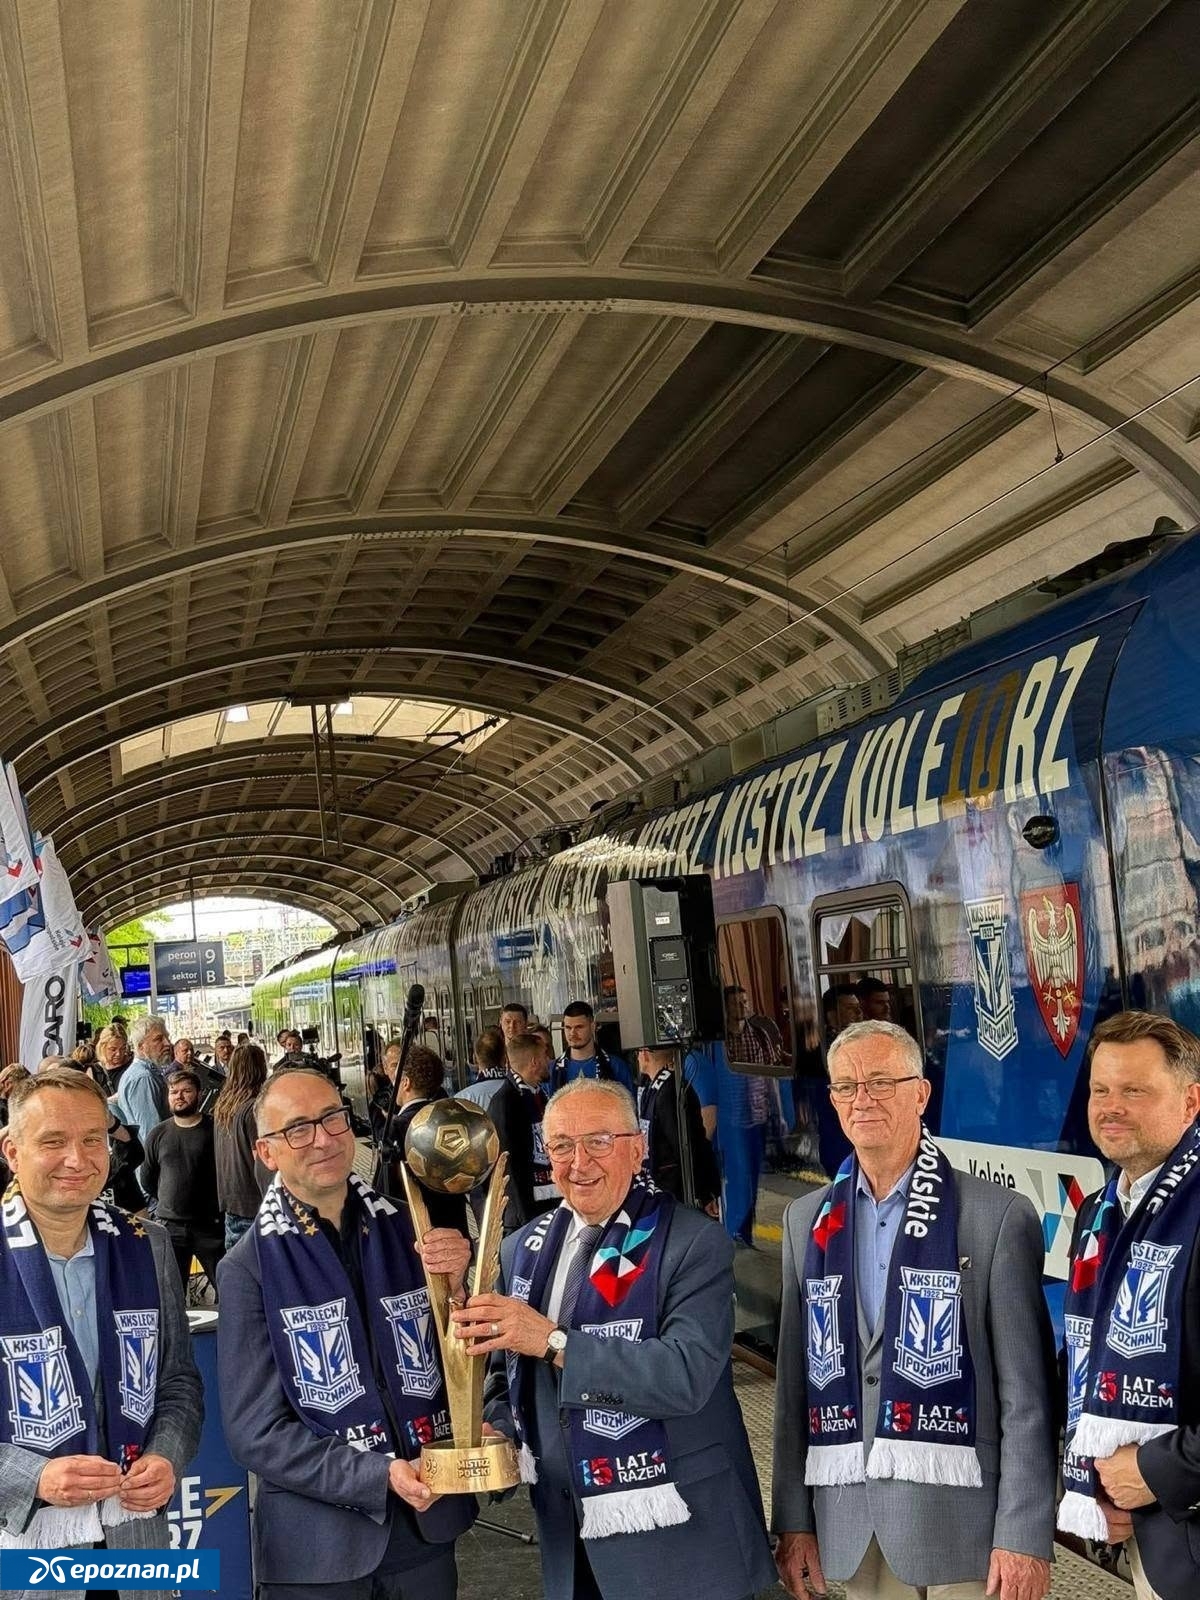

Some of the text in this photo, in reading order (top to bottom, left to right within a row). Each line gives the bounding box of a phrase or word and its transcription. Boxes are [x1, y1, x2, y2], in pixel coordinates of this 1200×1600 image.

[713, 739, 849, 880] MISTRZ
[168, 948, 216, 964] peron 9
[172, 970, 216, 983] sektor B
[1134, 1260, 1153, 1271] 1922
[909, 1272, 957, 1289] KKS LECH
[923, 1289, 941, 1299] 1922
[119, 1314, 138, 1327] KKS
[291, 1304, 339, 1325] KKS LECH
[309, 1323, 328, 1332] 1922
[1073, 1321, 1091, 1336] LEC
[13, 1337, 37, 1353] KKS
[1122, 1374, 1155, 1393] LAT
[1122, 1391, 1174, 1409] RAZEM
[432, 1410, 447, 1426] LAT
[820, 1405, 839, 1419] LAT
[882, 1399, 952, 1433] 15 LAT
[434, 1422, 451, 1439] RAZE
[821, 1417, 857, 1432] RAZEM
[917, 1418, 969, 1434] RAZEM
[457, 1467, 490, 1478] POLSKI
[578, 1452, 648, 1487] 15 LAT
[617, 1463, 667, 1483] RAZEM
